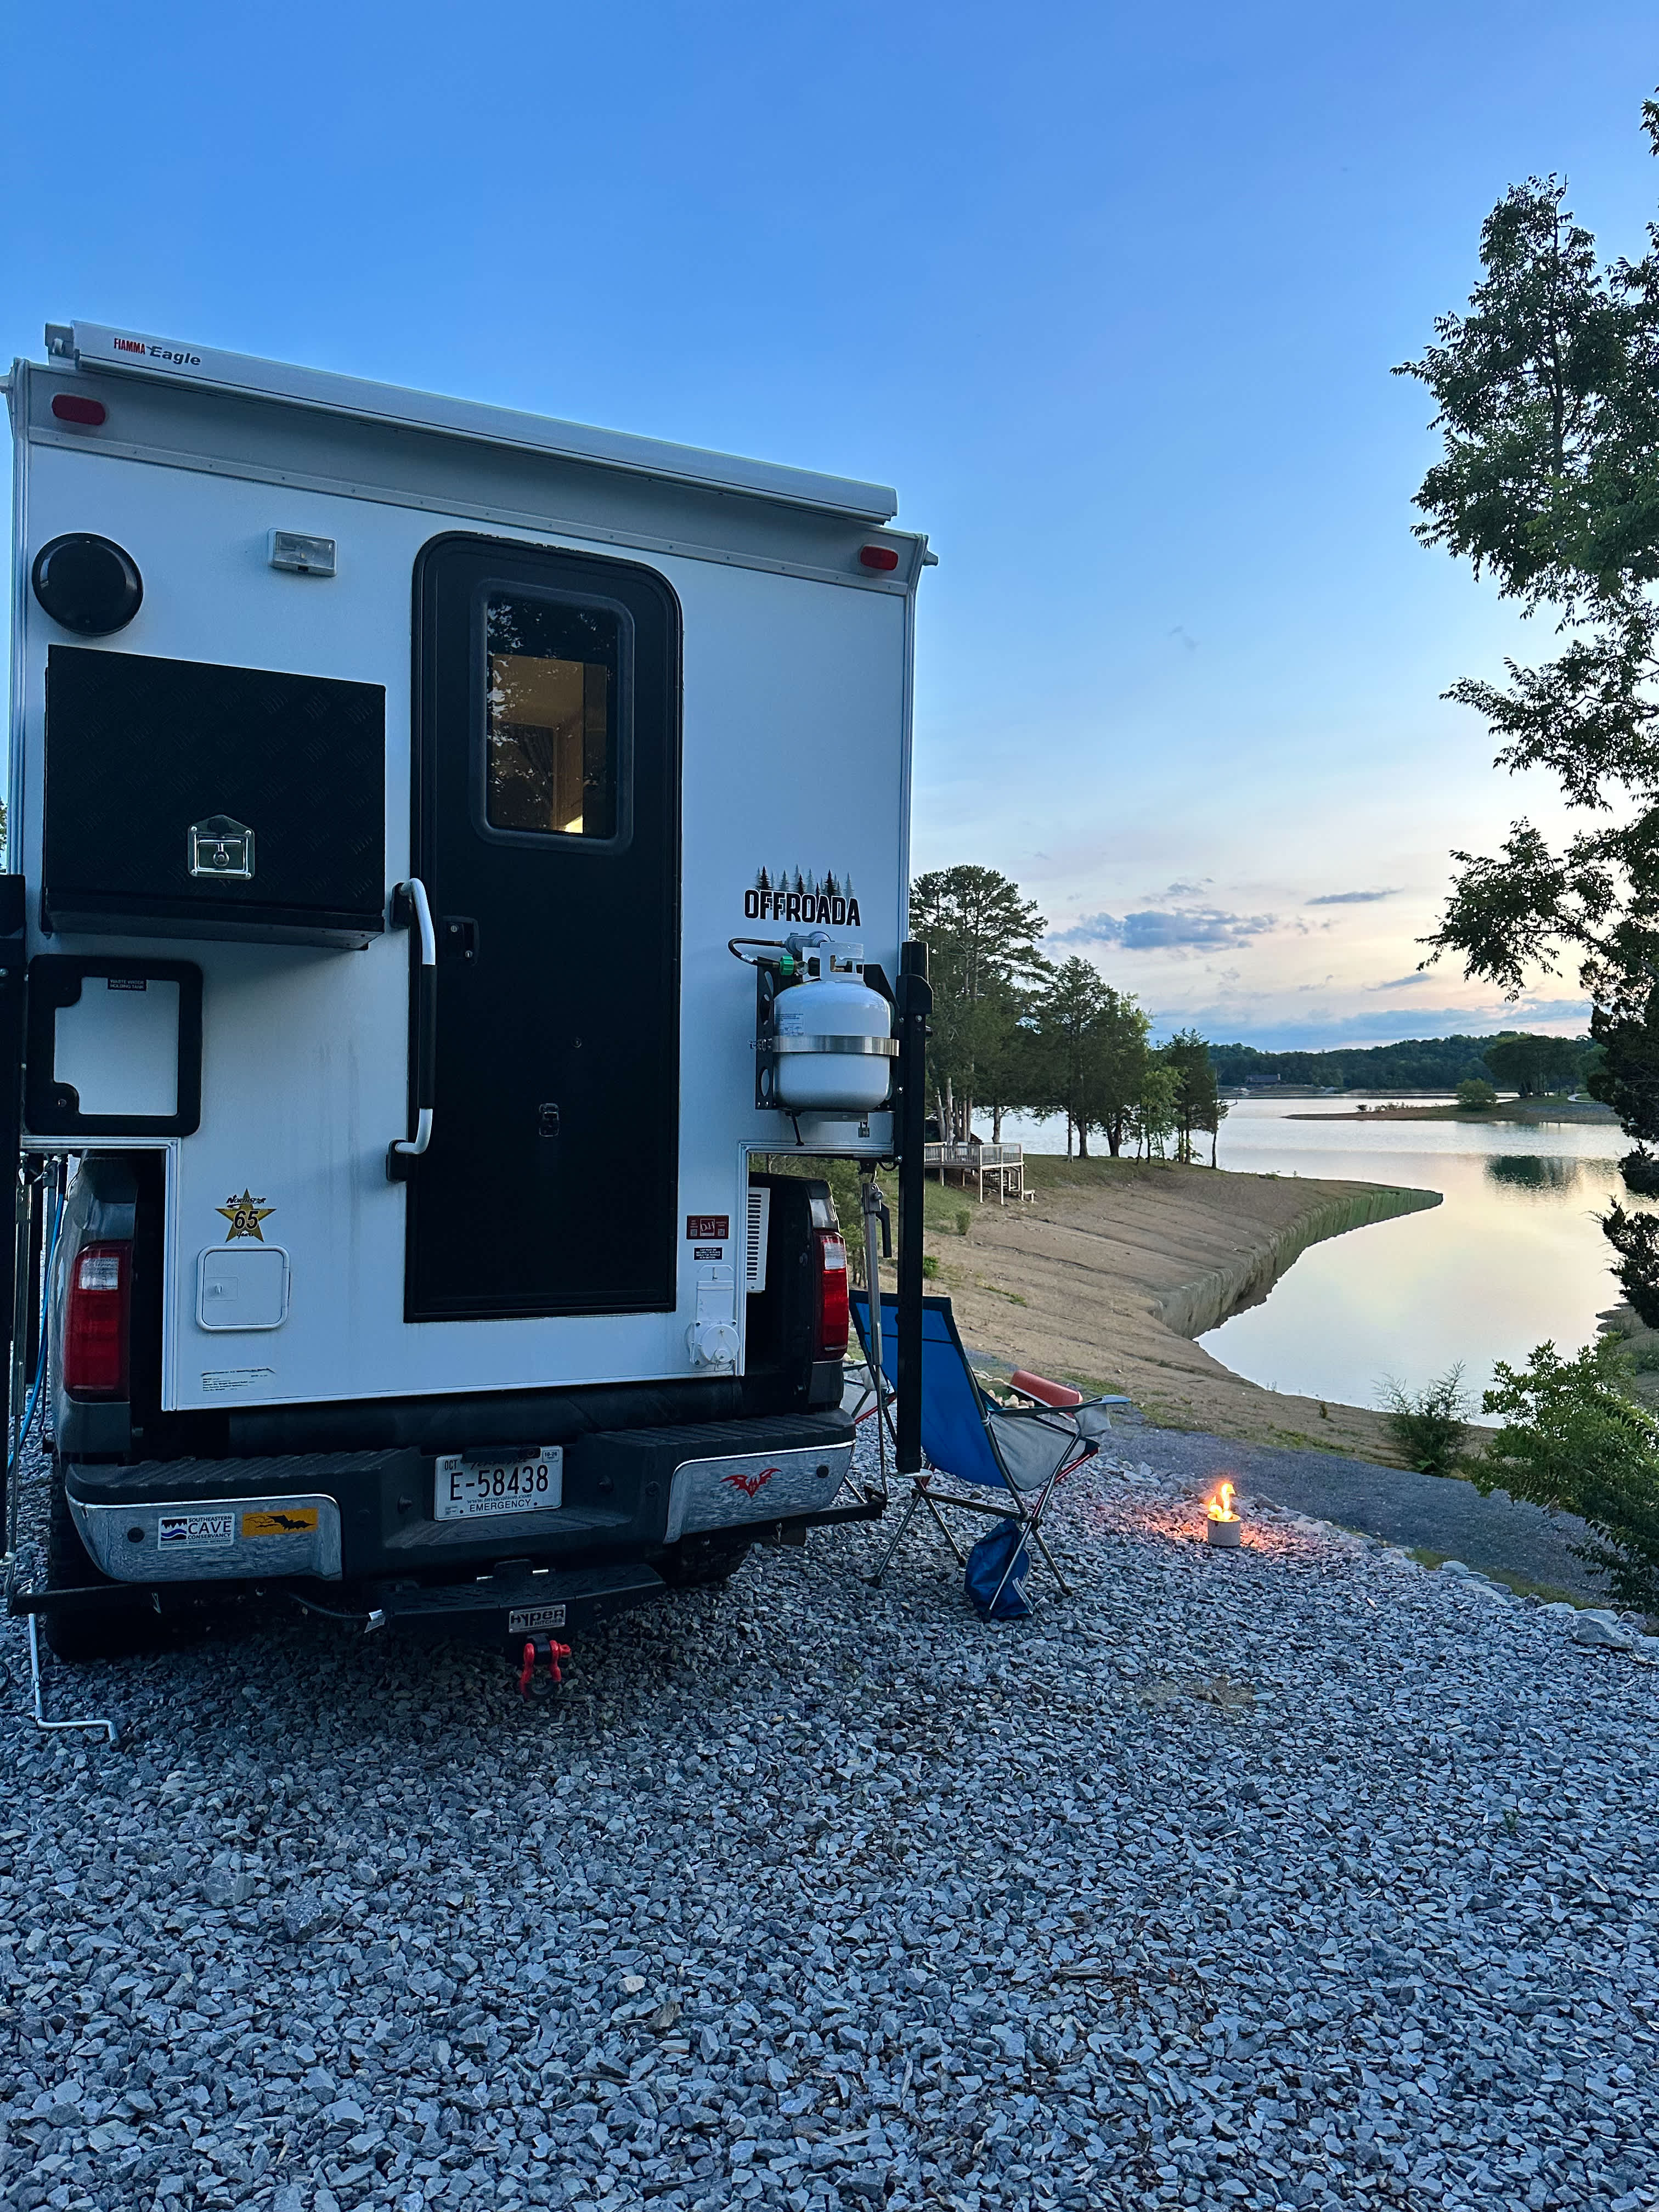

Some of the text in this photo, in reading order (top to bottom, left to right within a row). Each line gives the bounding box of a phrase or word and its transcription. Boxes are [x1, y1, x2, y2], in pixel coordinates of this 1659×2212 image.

[114, 337, 201, 365] FIAMMA Eagle
[744, 889, 861, 927] OFFROADA
[234, 1210, 258, 1229] 65
[444, 1460, 458, 1470] OCT
[450, 1464, 548, 1501] E-58438
[467, 1493, 532, 1504] www.tnvacation.com
[470, 1498, 532, 1513] EMERGENCY
[188, 1520, 232, 1534] CAVE
